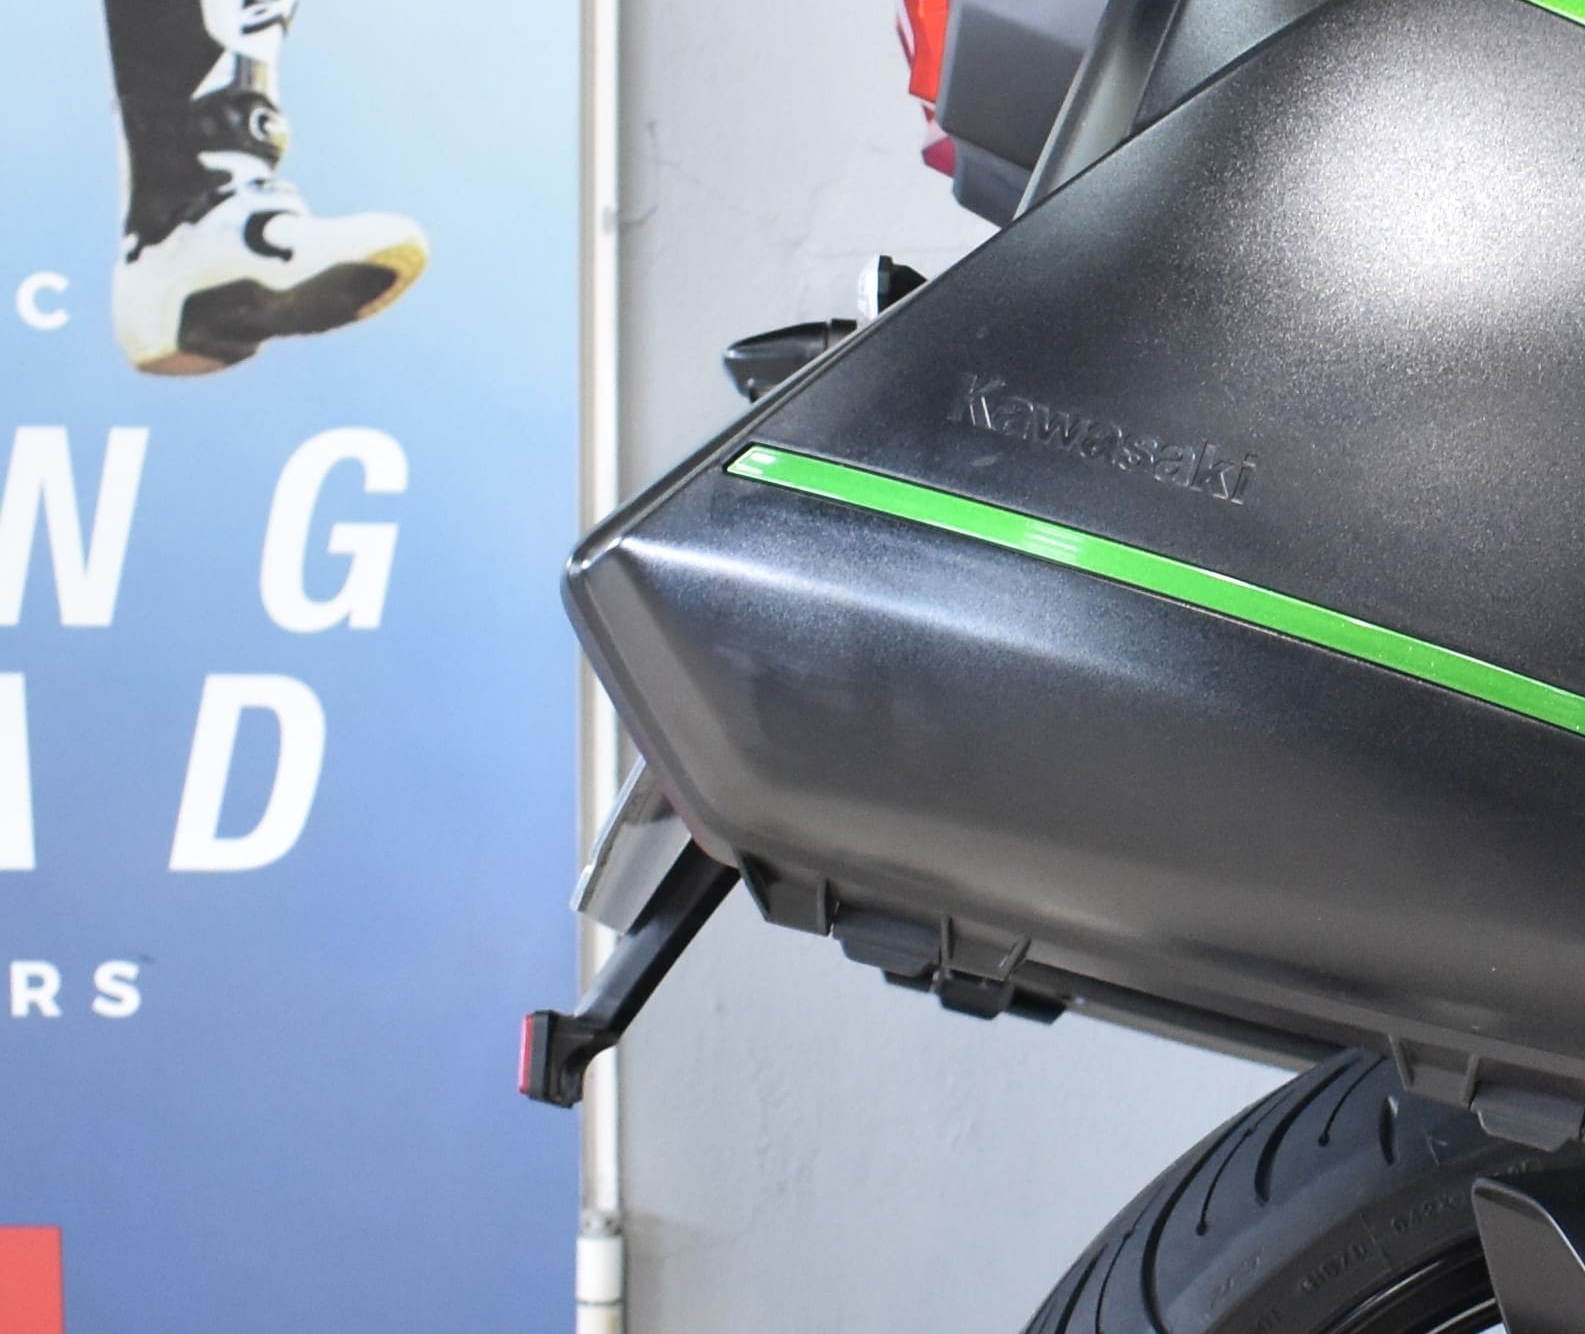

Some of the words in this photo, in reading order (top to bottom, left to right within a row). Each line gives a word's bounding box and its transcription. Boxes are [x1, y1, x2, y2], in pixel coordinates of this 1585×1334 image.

[16, 271, 70, 330] C
[945, 373, 1257, 505] Kawasaki
[9, 960, 141, 1018] RS
